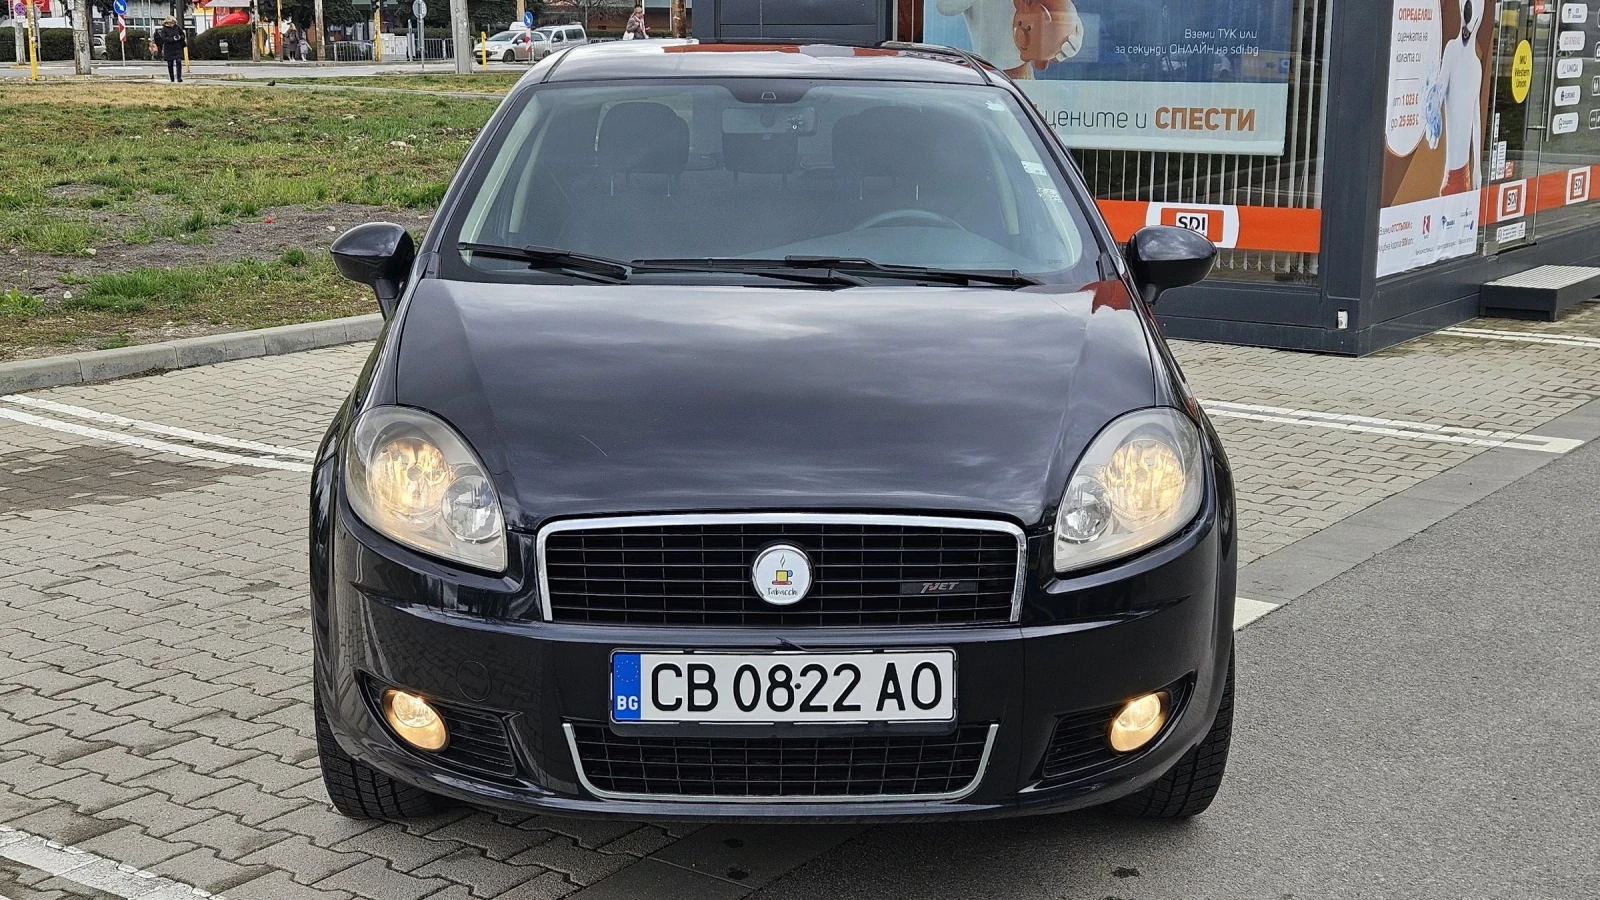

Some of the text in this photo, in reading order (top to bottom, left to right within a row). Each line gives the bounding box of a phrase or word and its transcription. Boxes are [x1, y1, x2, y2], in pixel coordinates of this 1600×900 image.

[1398, 8, 1433, 22] ОПРЕДЕЛЯШ
[1184, 28, 1258, 39] Вземи ТУК или
[1114, 42, 1259, 57] за секунди ОНЛАЙН на sdi.bg
[1135, 111, 1147, 129] и
[1155, 106, 1256, 132] СПЕСТИ
[1178, 215, 1206, 231] SDI
[651, 661, 942, 713] CB 0822 AO
[616, 695, 639, 711] BG
